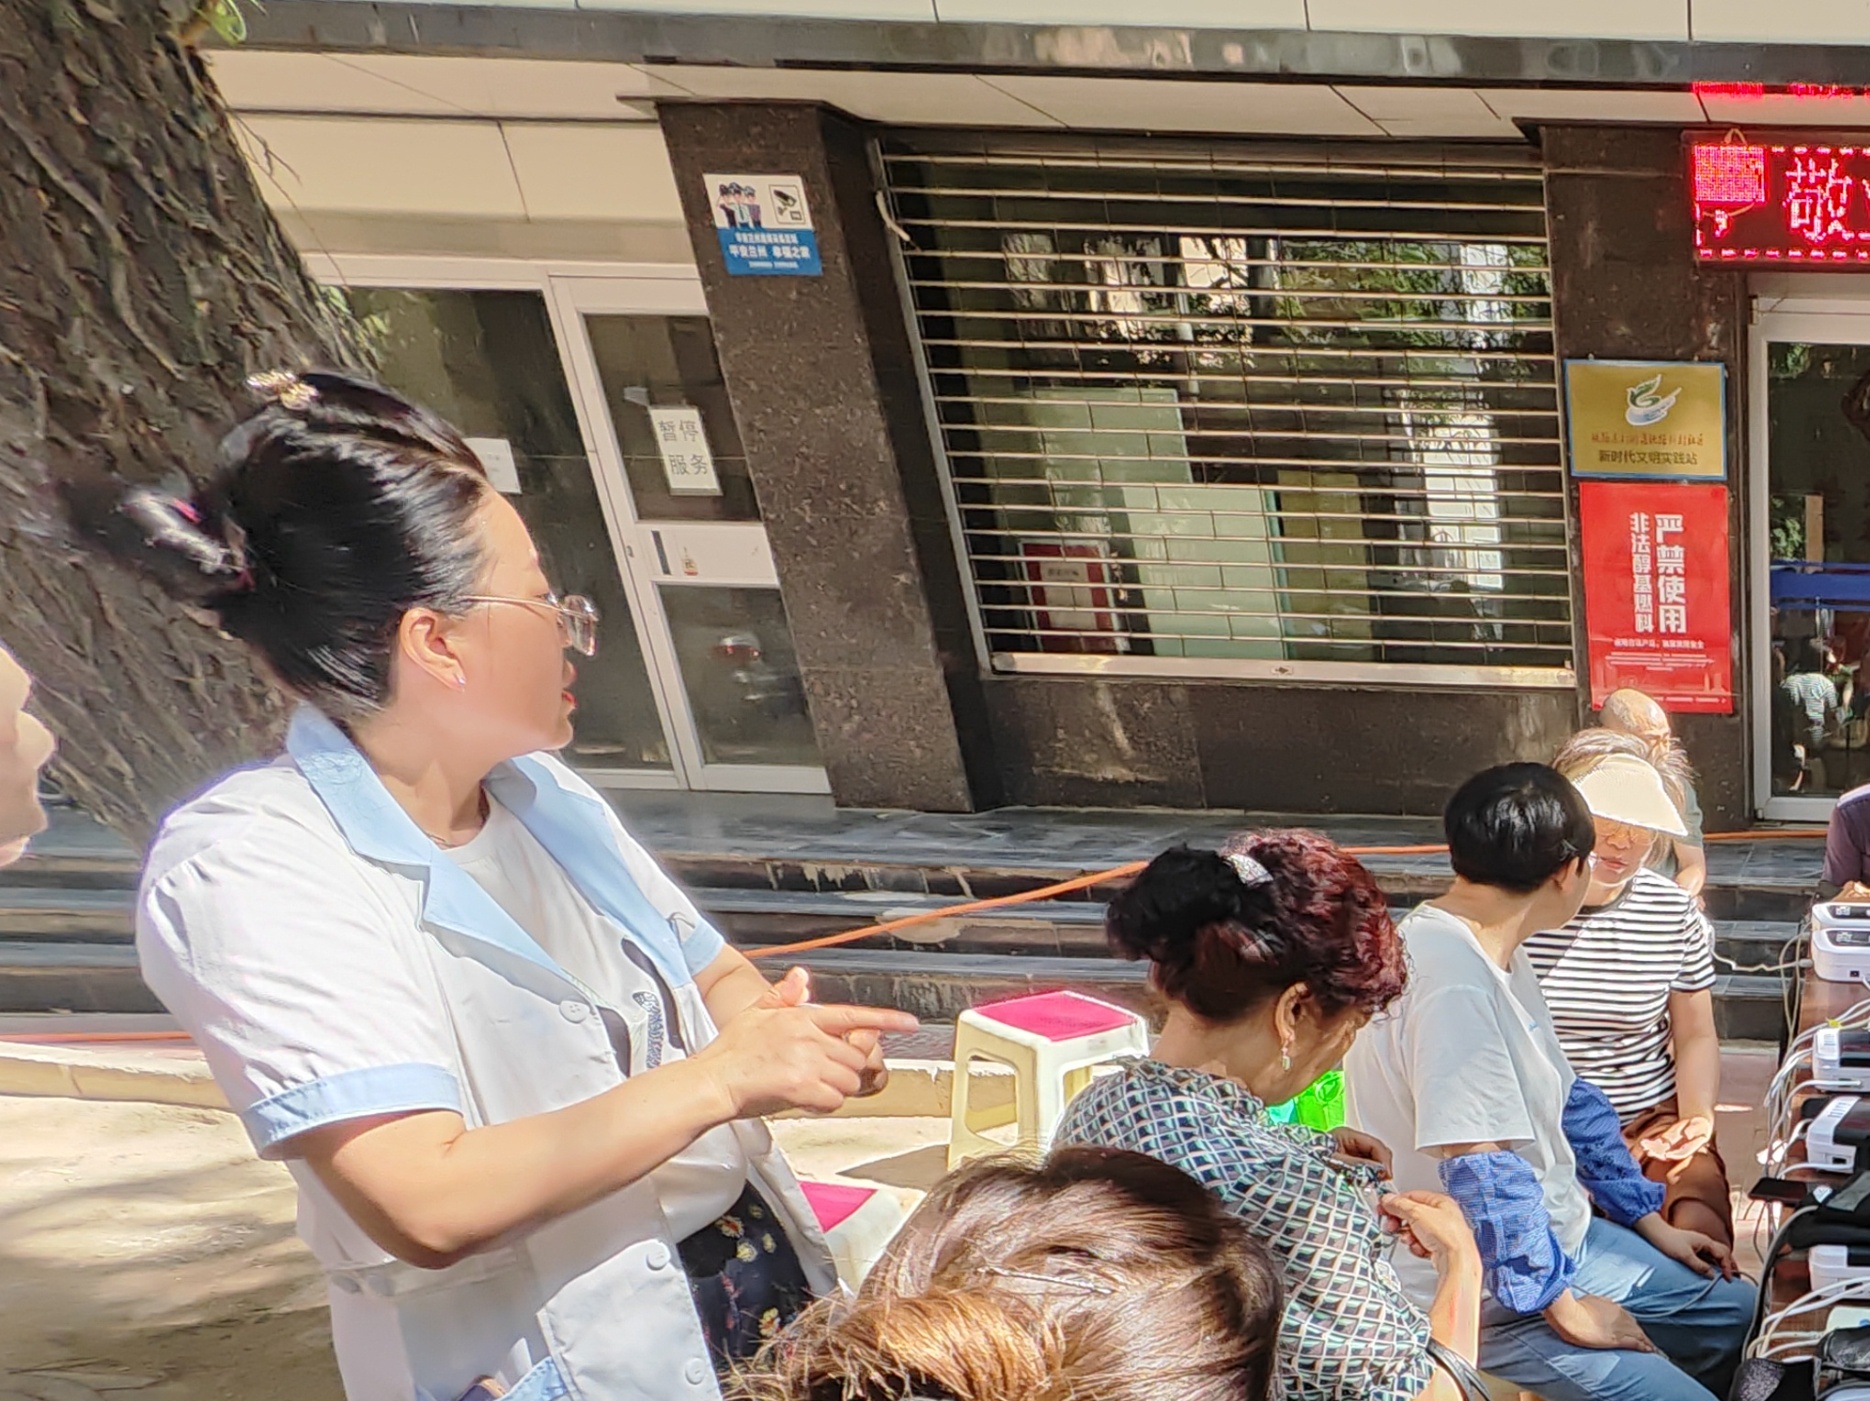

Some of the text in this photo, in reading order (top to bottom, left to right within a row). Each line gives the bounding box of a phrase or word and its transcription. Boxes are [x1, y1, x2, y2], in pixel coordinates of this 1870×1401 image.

[658, 420, 698, 441] 暂停
[668, 454, 707, 475] 服务
[1599, 449, 1698, 465] 新时代文明实践站
[1629, 511, 1654, 633] 非法醇基燃料
[1655, 513, 1687, 634] 严禁使用
